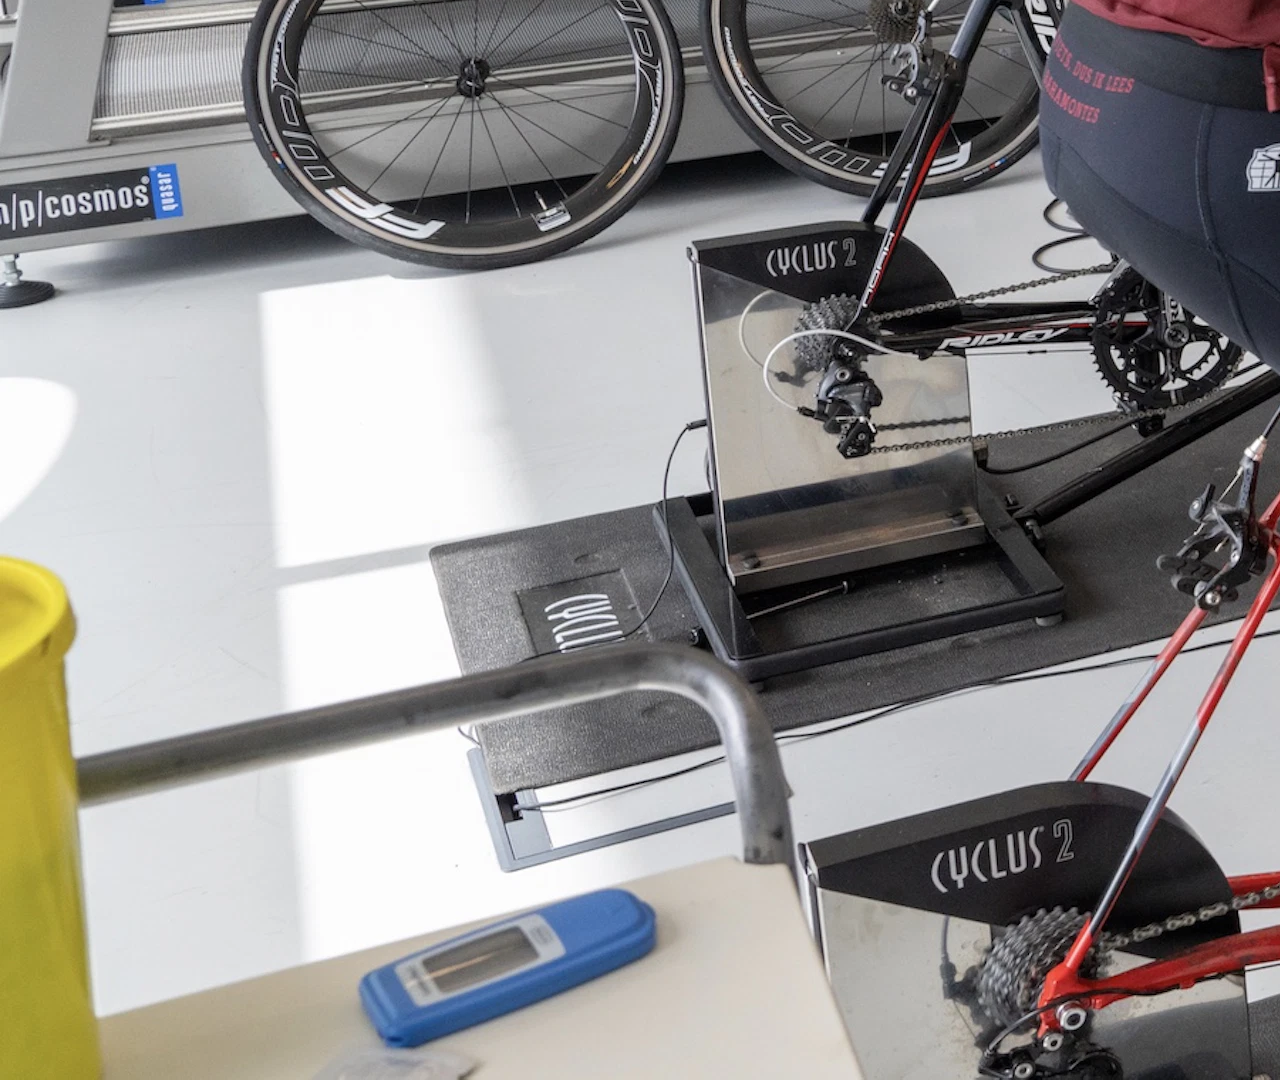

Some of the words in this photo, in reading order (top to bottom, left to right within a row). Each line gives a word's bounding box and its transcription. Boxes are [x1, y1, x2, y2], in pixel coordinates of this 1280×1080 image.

[1072, 60, 1093, 85] DUS
[1104, 75, 1136, 95] LEES
[765, 240, 838, 278] CYCLUS
[842, 237, 858, 268] 2
[937, 327, 1070, 351] RIDLEY
[930, 825, 1043, 894] CYCLUS
[1052, 818, 1075, 863] 2
